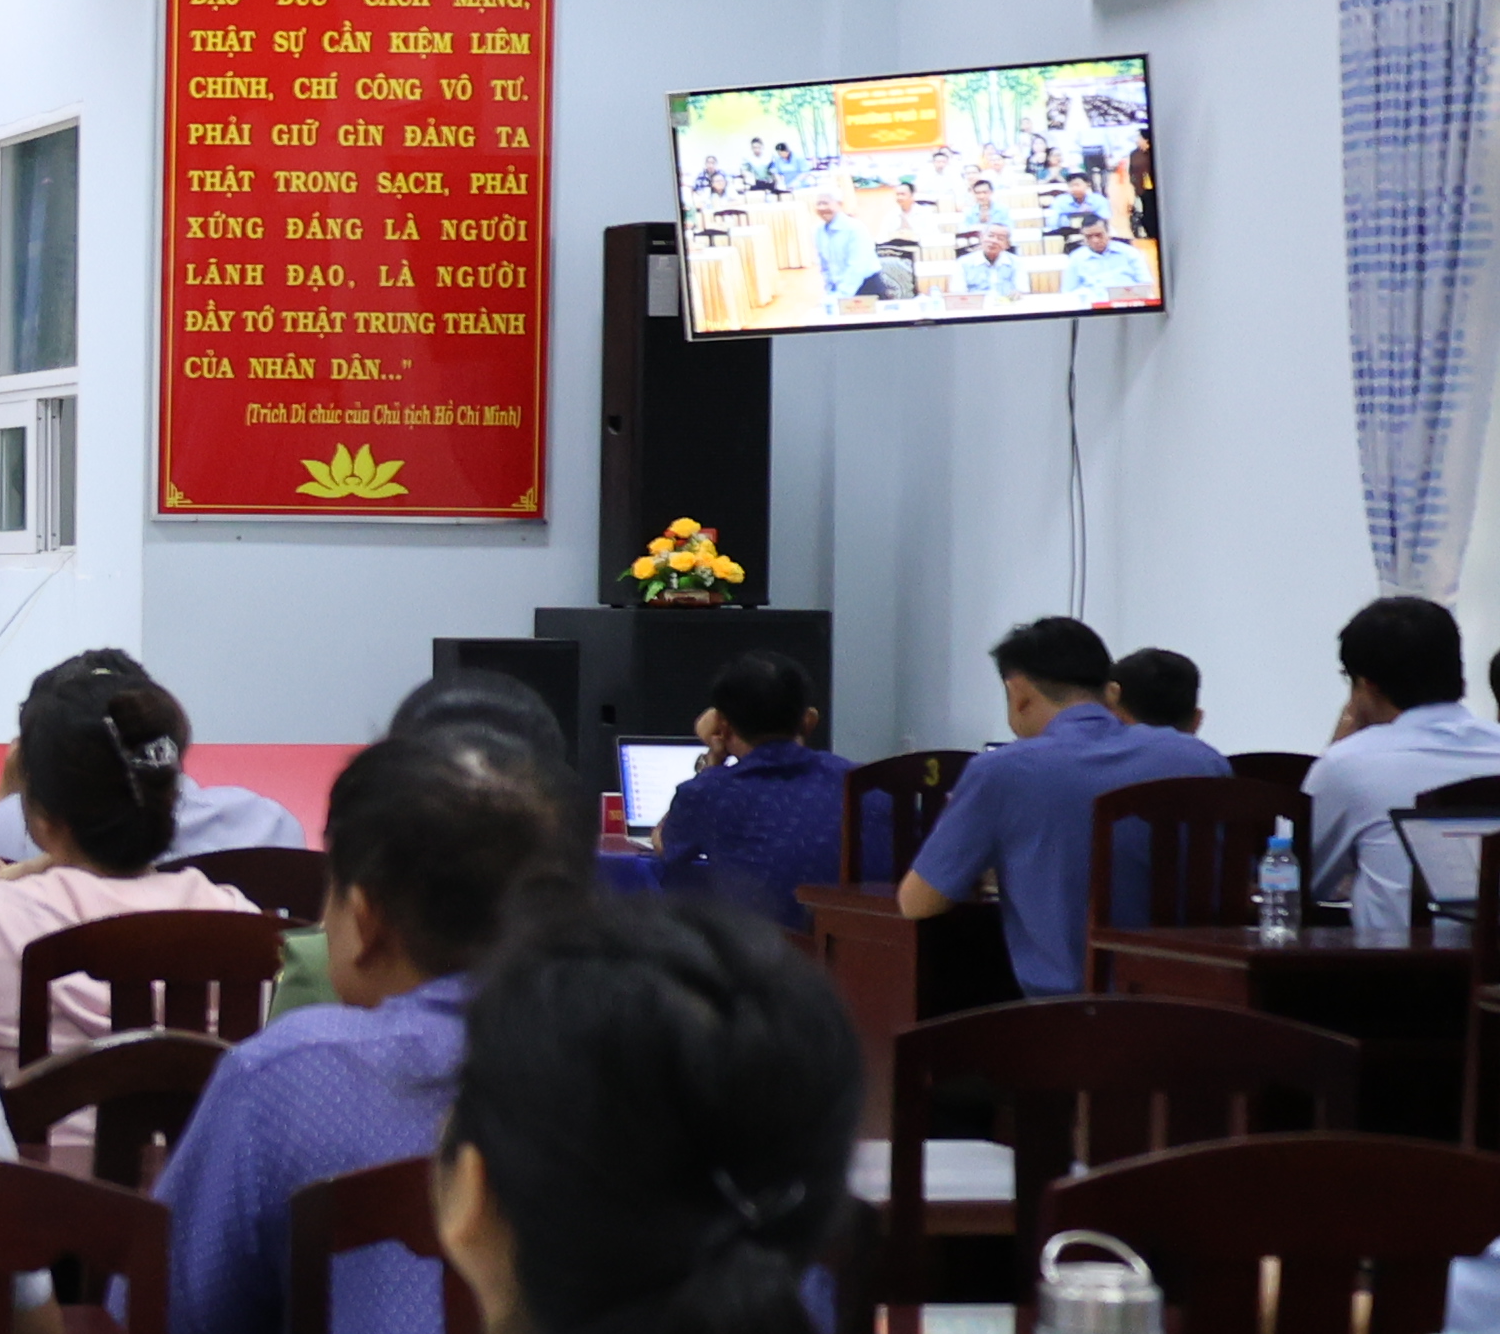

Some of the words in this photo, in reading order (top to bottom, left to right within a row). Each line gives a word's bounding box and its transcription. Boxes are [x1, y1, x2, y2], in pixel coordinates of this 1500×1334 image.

[191, 25, 256, 57] THẬT
[274, 28, 306, 57] SỰ
[323, 21, 372, 52] CẦN
[390, 27, 453, 58] KIỆM
[471, 28, 530, 54] LIÊM
[189, 71, 273, 100] CHÍNH,
[294, 72, 337, 99] CHÍ
[356, 73, 422, 100] CÔNG
[440, 74, 472, 100] VÔ
[491, 77, 528, 101] TƯ.
[189, 117, 251, 145] PHẢI
[272, 119, 319, 145] GIỮ
[339, 119, 383, 146] GÌN
[404, 118, 475, 147] ĐẢNG
[497, 127, 529, 147] TA
[188, 165, 254, 197] THẬT
[275, 171, 357, 192] TRONG
[378, 172, 449, 198] SẠCH,
[470, 166, 528, 194] PHẢI
[187, 211, 264, 238] XỨNG
[286, 212, 363, 239] ĐÁNG
[385, 213, 420, 240] LÀ
[441, 214, 527, 241] NGƯỜI
[186, 258, 263, 285] LÃNH
[287, 265, 354, 291] ĐẠO,
[379, 260, 414, 286] LÀ
[437, 261, 526, 288] NGƯỜI
[185, 300, 235, 331] ĐẦY
[243, 305, 274, 332] TỚ
[282, 306, 346, 338] THẬT
[354, 312, 435, 333] TRUNG
[444, 308, 525, 334] THÀNH
[185, 350, 234, 378] CỦA
[249, 353, 315, 379] NHÂN
